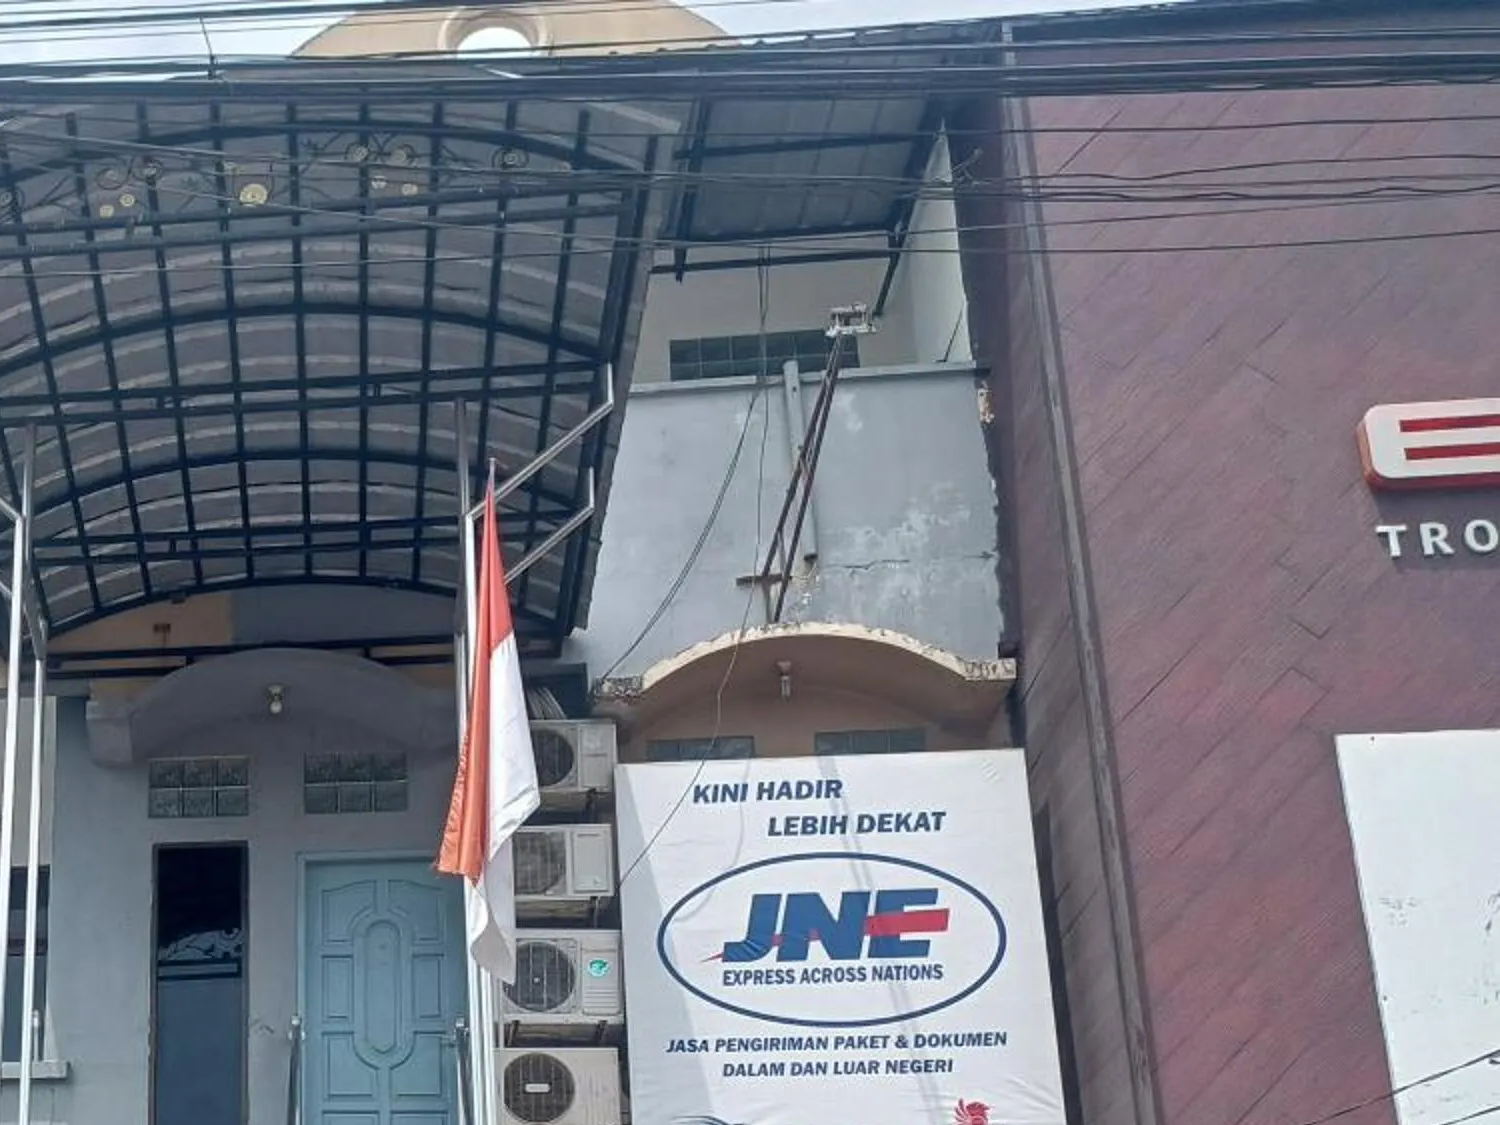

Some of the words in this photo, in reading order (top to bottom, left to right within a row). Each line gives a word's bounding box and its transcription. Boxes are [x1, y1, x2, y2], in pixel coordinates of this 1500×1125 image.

[693, 783, 749, 804] KINI
[756, 779, 843, 801] HADIR
[767, 815, 849, 837] LEBIH
[855, 811, 947, 834] DEKAT
[703, 887, 950, 963] JNE
[722, 967, 796, 986] EXPRESS
[800, 966, 867, 984] ACROSS
[872, 964, 944, 983] NATIONS
[666, 1038, 709, 1053] JASA
[715, 1036, 828, 1052] PENGIRIMAN
[834, 1034, 891, 1050] PAKET
[895, 1034, 908, 1049] &
[914, 1031, 1007, 1048] DOKUMEN
[722, 1063, 785, 1077] DALAM
[790, 1062, 828, 1076] DAN
[834, 1060, 880, 1075] LUAR
[885, 1059, 953, 1074] NEGERI
